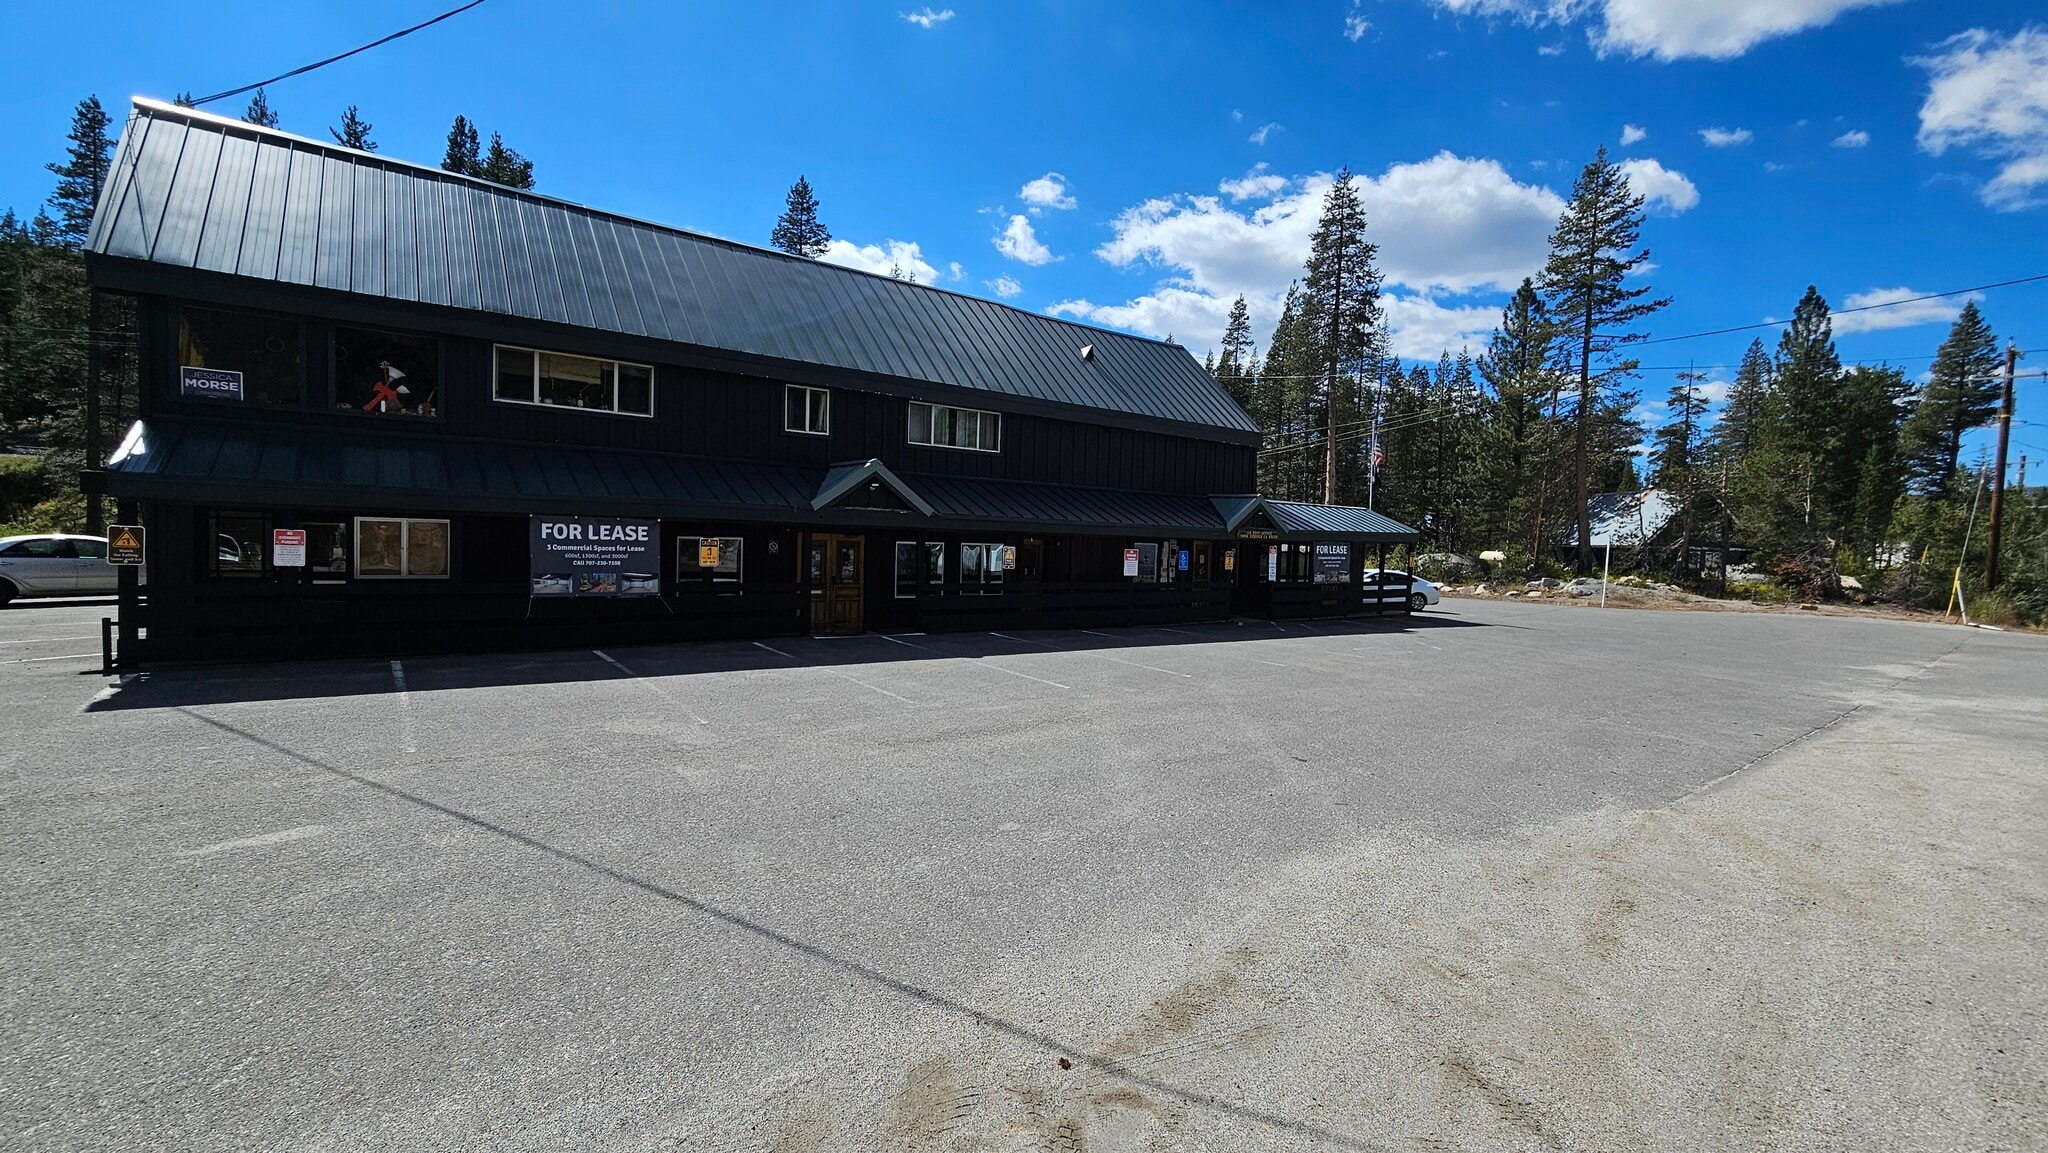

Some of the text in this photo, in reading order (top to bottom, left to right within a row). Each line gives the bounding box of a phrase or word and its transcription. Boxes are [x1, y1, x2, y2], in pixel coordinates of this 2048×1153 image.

[191, 372, 233, 381] JESSICA
[185, 378, 239, 391] MORSE
[541, 523, 649, 541] FOR LEASE
[1316, 545, 1348, 554] FOR LEASE
